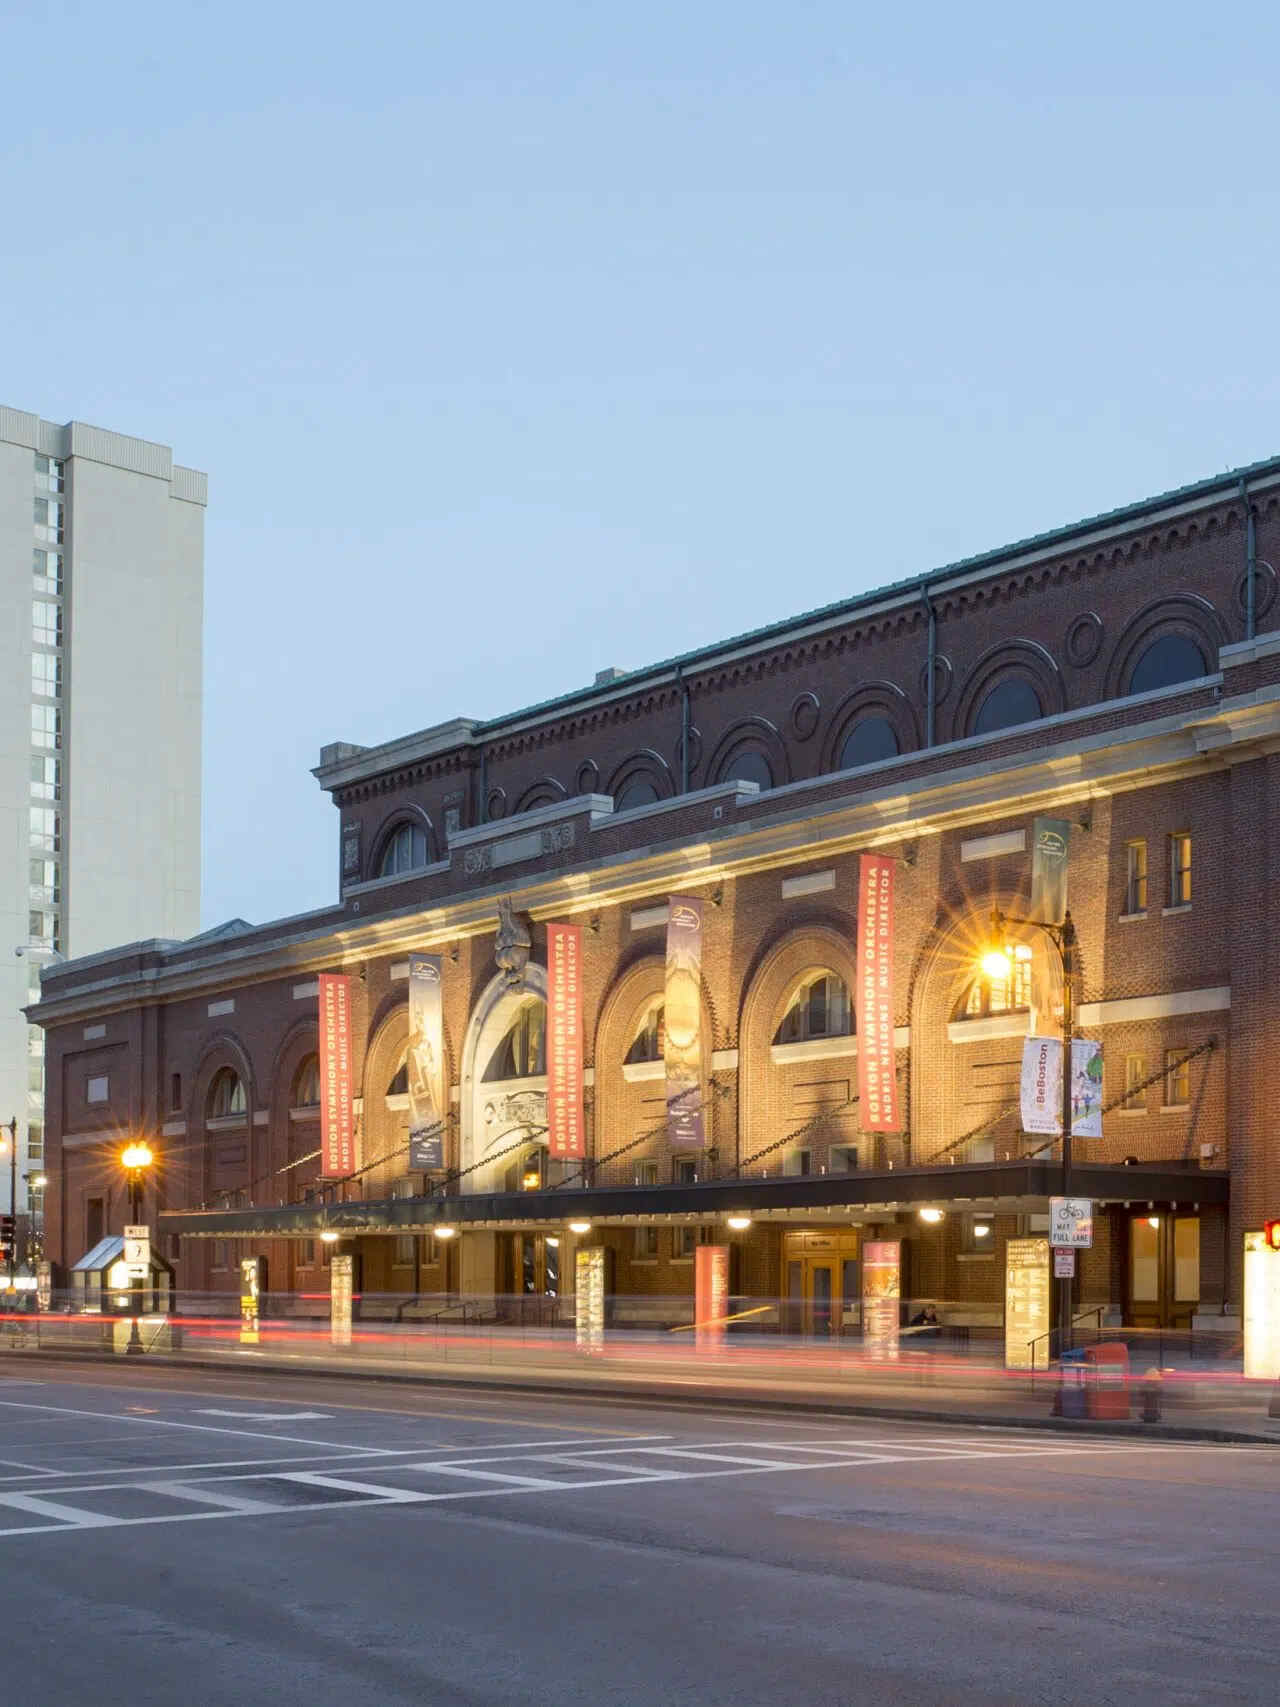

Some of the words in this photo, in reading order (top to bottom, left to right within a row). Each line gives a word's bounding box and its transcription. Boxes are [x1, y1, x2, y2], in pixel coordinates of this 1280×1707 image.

[865, 867, 879, 959] ORCHESTRA
[879, 869, 889, 937] DIRECTOR
[555, 933, 566, 1012] ORCHESTRA
[567, 934, 577, 993] DIRECTOR
[879, 943, 889, 987] MUSIC
[326, 982, 336, 1050] ORCHESTRA
[338, 983, 346, 1033] DIRECTOR
[567, 996, 577, 1035] MUSIC
[865, 965, 877, 1056] SYMPHONY
[880, 1003, 890, 1065] NELSONS
[339, 1036, 347, 1071] MUSIC
[554, 1016, 566, 1093] SYMPHONY
[568, 1046, 577, 1102] NELSONS
[328, 1054, 337, 1120] SYMPHONY
[340, 1080, 348, 1127] NELSONS
[869, 1061, 880, 1123] BOSTON
[881, 1071, 892, 1123] ANDRIS
[329, 1123, 338, 1170] BOSTON
[341, 1131, 349, 1170] ANDRIS
[555, 1098, 567, 1151] BOSTON
[569, 1108, 578, 1151] ANDRIS
[1053, 1232, 1070, 1242] FULL
[1072, 1233, 1089, 1242] LANE
[1056, 1223, 1070, 1231] MAY
